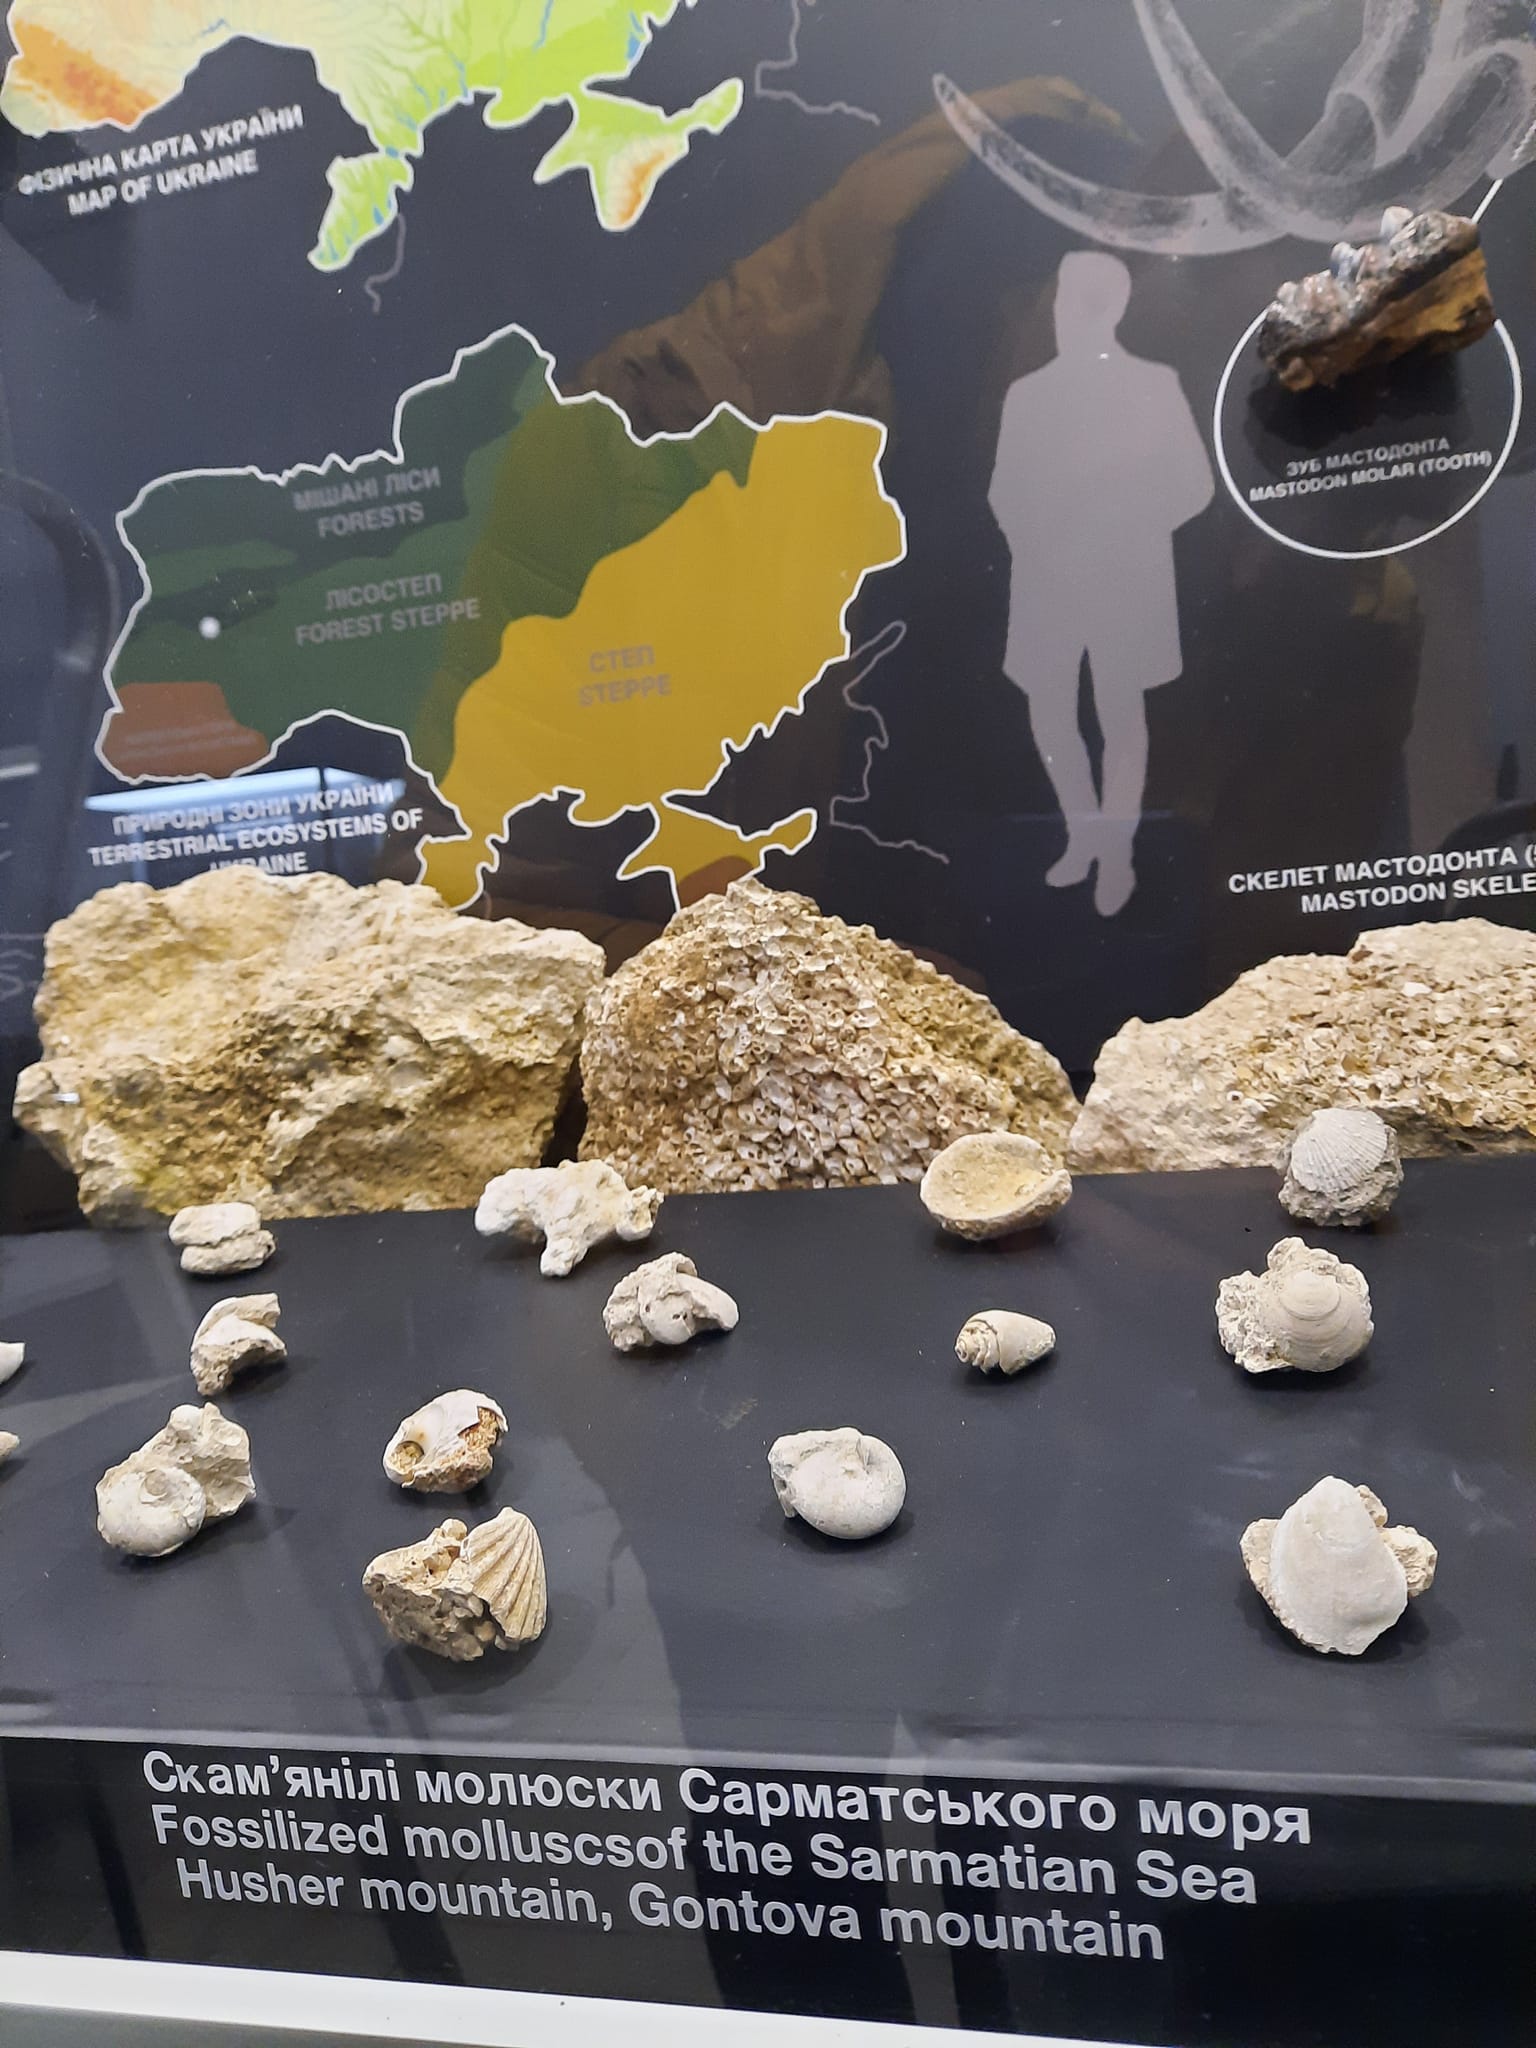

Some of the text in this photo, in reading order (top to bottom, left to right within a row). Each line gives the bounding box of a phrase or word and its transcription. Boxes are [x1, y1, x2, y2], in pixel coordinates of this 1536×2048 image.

[120, 133, 198, 170] КАРТА
[200, 104, 305, 150] УКРАЇНИ
[67, 148, 259, 216] MAP OF UKRAINE
[1249, 450, 1493, 502] MASTODON MOLAR (TOOTH)
[1286, 437, 1450, 477] ЗУБ МАСТОДОНТА
[293, 466, 441, 511] МІШАНІ ЛІСИ
[317, 501, 425, 538] FORESTS
[325, 572, 443, 611] ЛІСОСТЕП
[295, 597, 481, 646] FOREST STEPPE
[589, 644, 655, 673] СТЕП
[578, 673, 673, 708] STEPPE
[111, 779, 394, 836] ПРИРОДНІ ЗОНИ УКРАЇНИ
[88, 808, 424, 867] TERRESTRIAL ECOSYSTEMS OF
[1228, 865, 1328, 894] СКЕЛЕТ
[1335, 846, 1518, 883] МАСТОДОНТА
[1301, 882, 1447, 914] MASTODON
[415, 1769, 662, 1812] молюски
[678, 1768, 1116, 1832] Сарматського
[1138, 1799, 1311, 1851] моря
[151, 1803, 1258, 1905] Fossilized molluscsof the Sarmatian Sea
[175, 1857, 1165, 1961] Husher mountain, Gontova mountain
